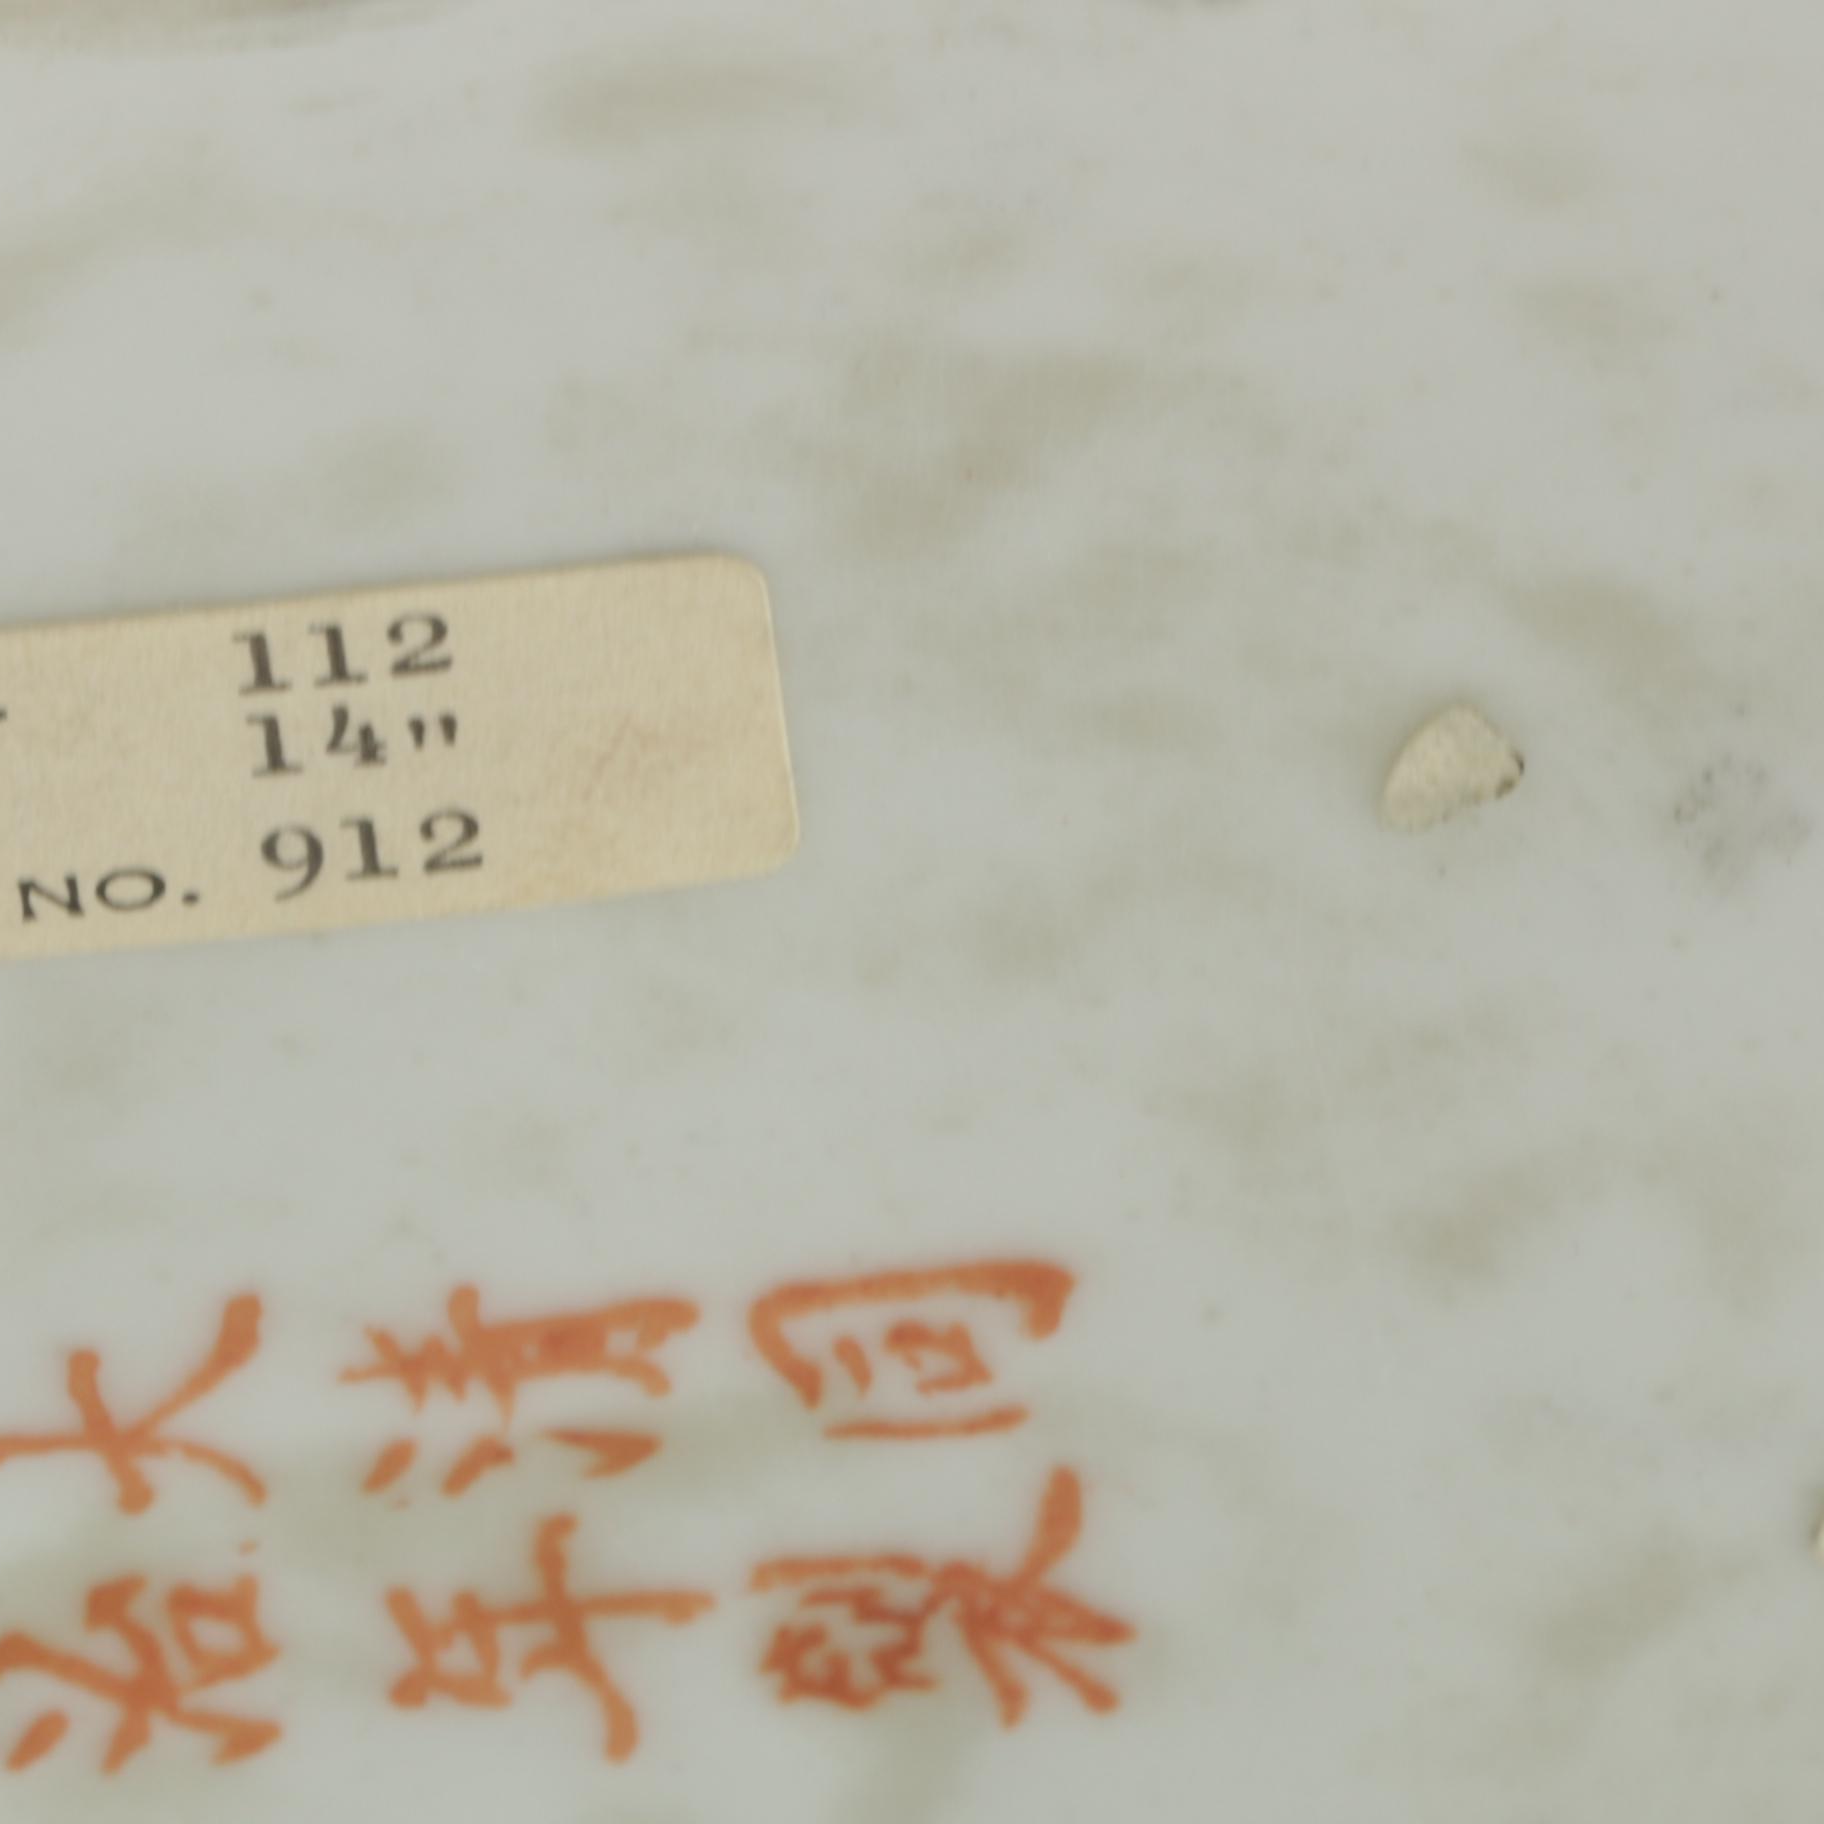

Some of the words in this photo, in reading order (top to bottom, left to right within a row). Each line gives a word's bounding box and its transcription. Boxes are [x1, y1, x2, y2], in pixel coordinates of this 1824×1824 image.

[231, 612, 455, 697] 112
[17, 866, 203, 924] NO.
[260, 808, 486, 902] 912
